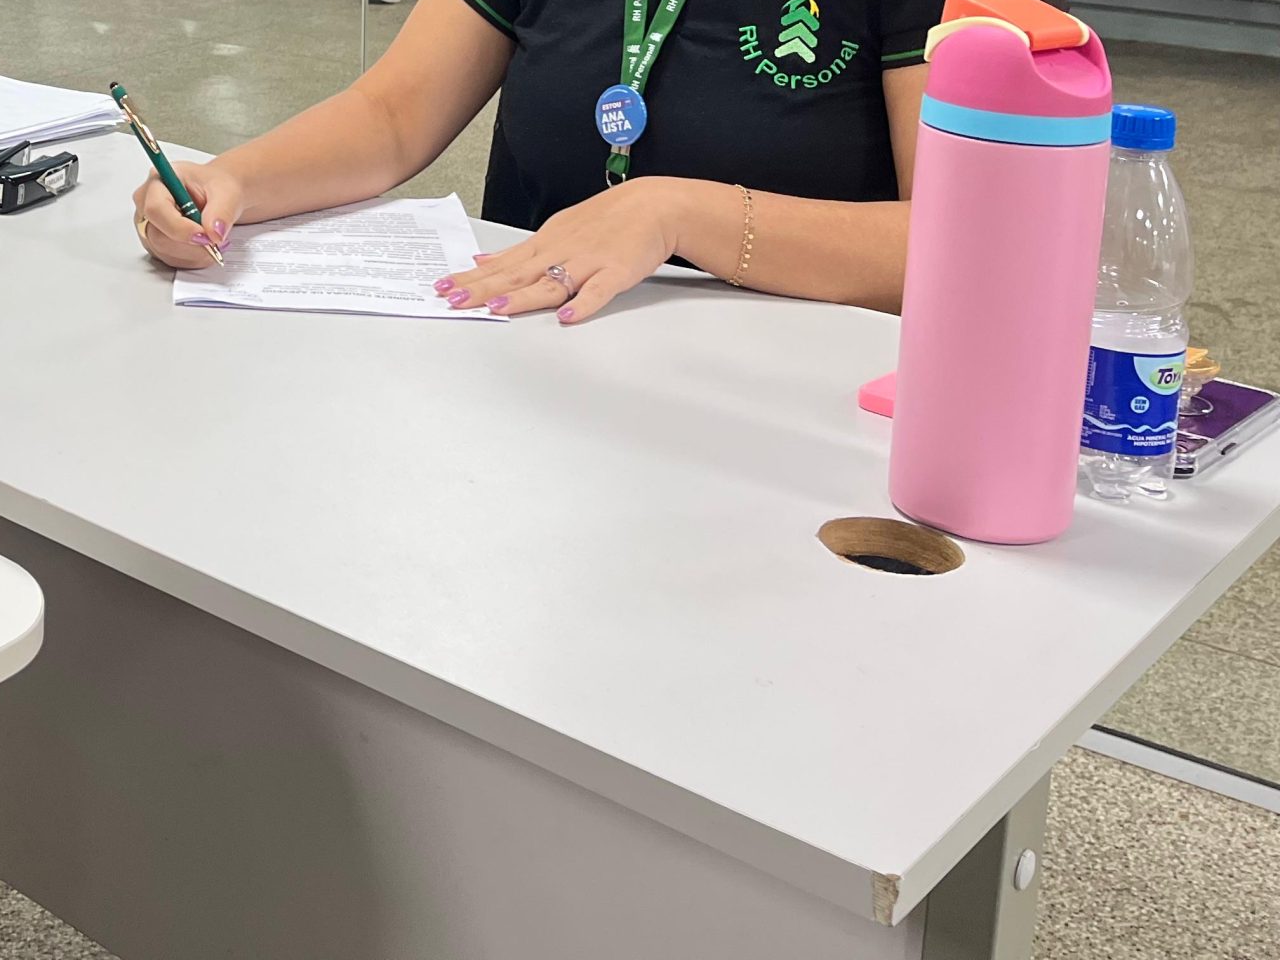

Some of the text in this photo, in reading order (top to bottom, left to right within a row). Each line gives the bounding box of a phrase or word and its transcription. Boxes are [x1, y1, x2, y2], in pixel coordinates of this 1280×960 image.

[665, 0, 678, 12] RH
[632, 10, 641, 22] RH
[634, 43, 656, 79] Personal
[738, 25, 859, 89] RH Personal
[602, 110, 625, 123] ANA
[603, 120, 632, 134] LISTA
